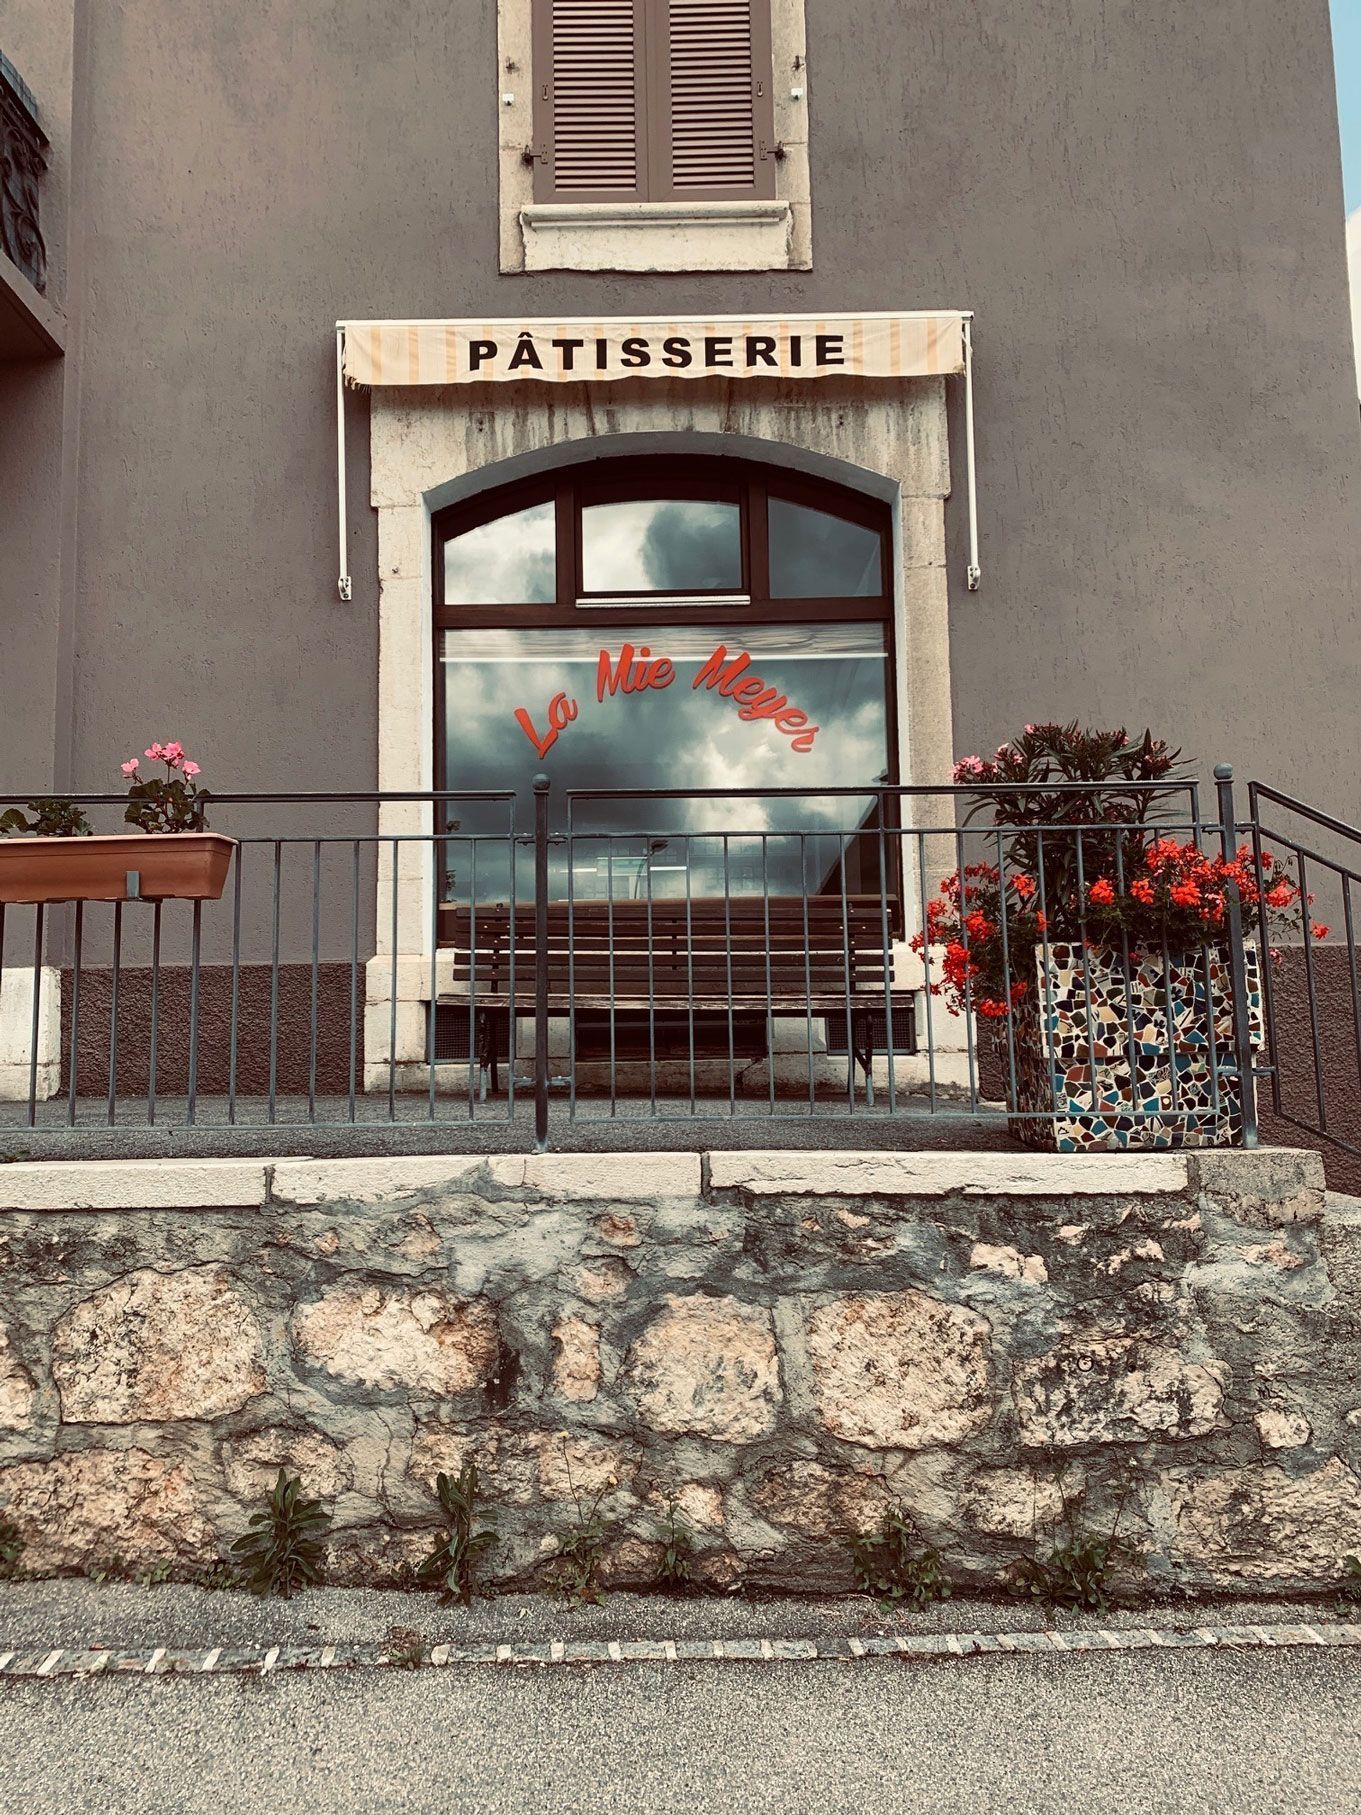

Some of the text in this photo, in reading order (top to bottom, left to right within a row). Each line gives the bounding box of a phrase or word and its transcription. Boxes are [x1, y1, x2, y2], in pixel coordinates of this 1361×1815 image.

[470, 332, 845, 371] PÂTISSERIE
[515, 643, 819, 758] La Mie Meyer
